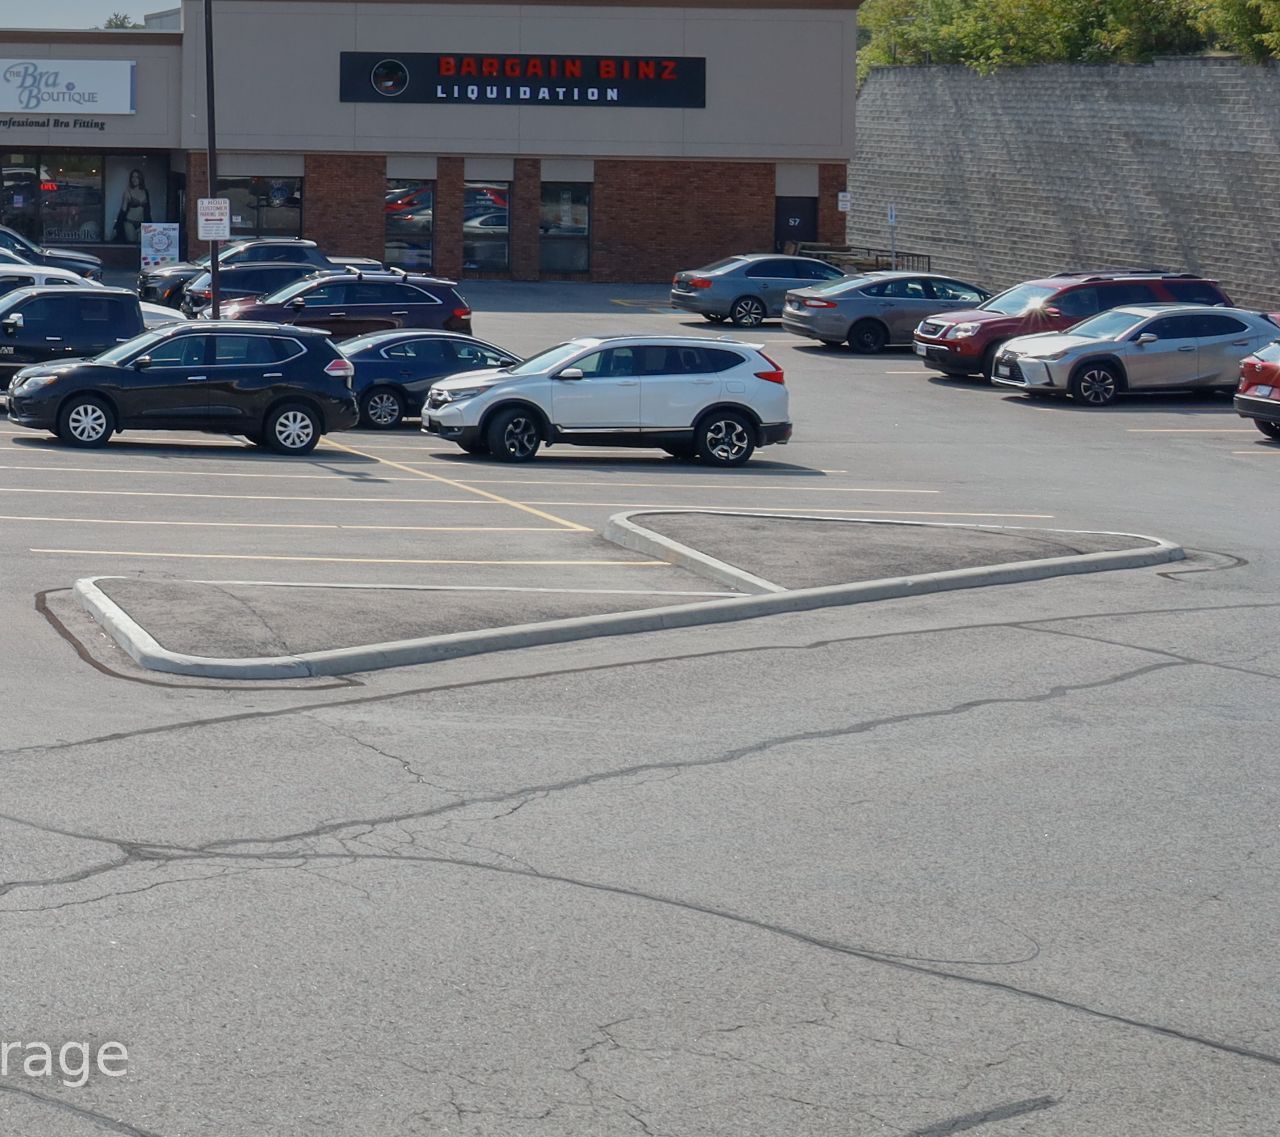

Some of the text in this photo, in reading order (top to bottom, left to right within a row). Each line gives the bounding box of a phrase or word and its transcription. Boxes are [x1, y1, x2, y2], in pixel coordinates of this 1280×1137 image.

[3, 62, 60, 89] Bra
[8, 70, 22, 78] THE
[439, 56, 678, 81] BARGAIN BINZ
[436, 85, 618, 102] LIQUIDATION
[53, 118, 70, 129] Bra
[73, 118, 106, 131] Fitting
